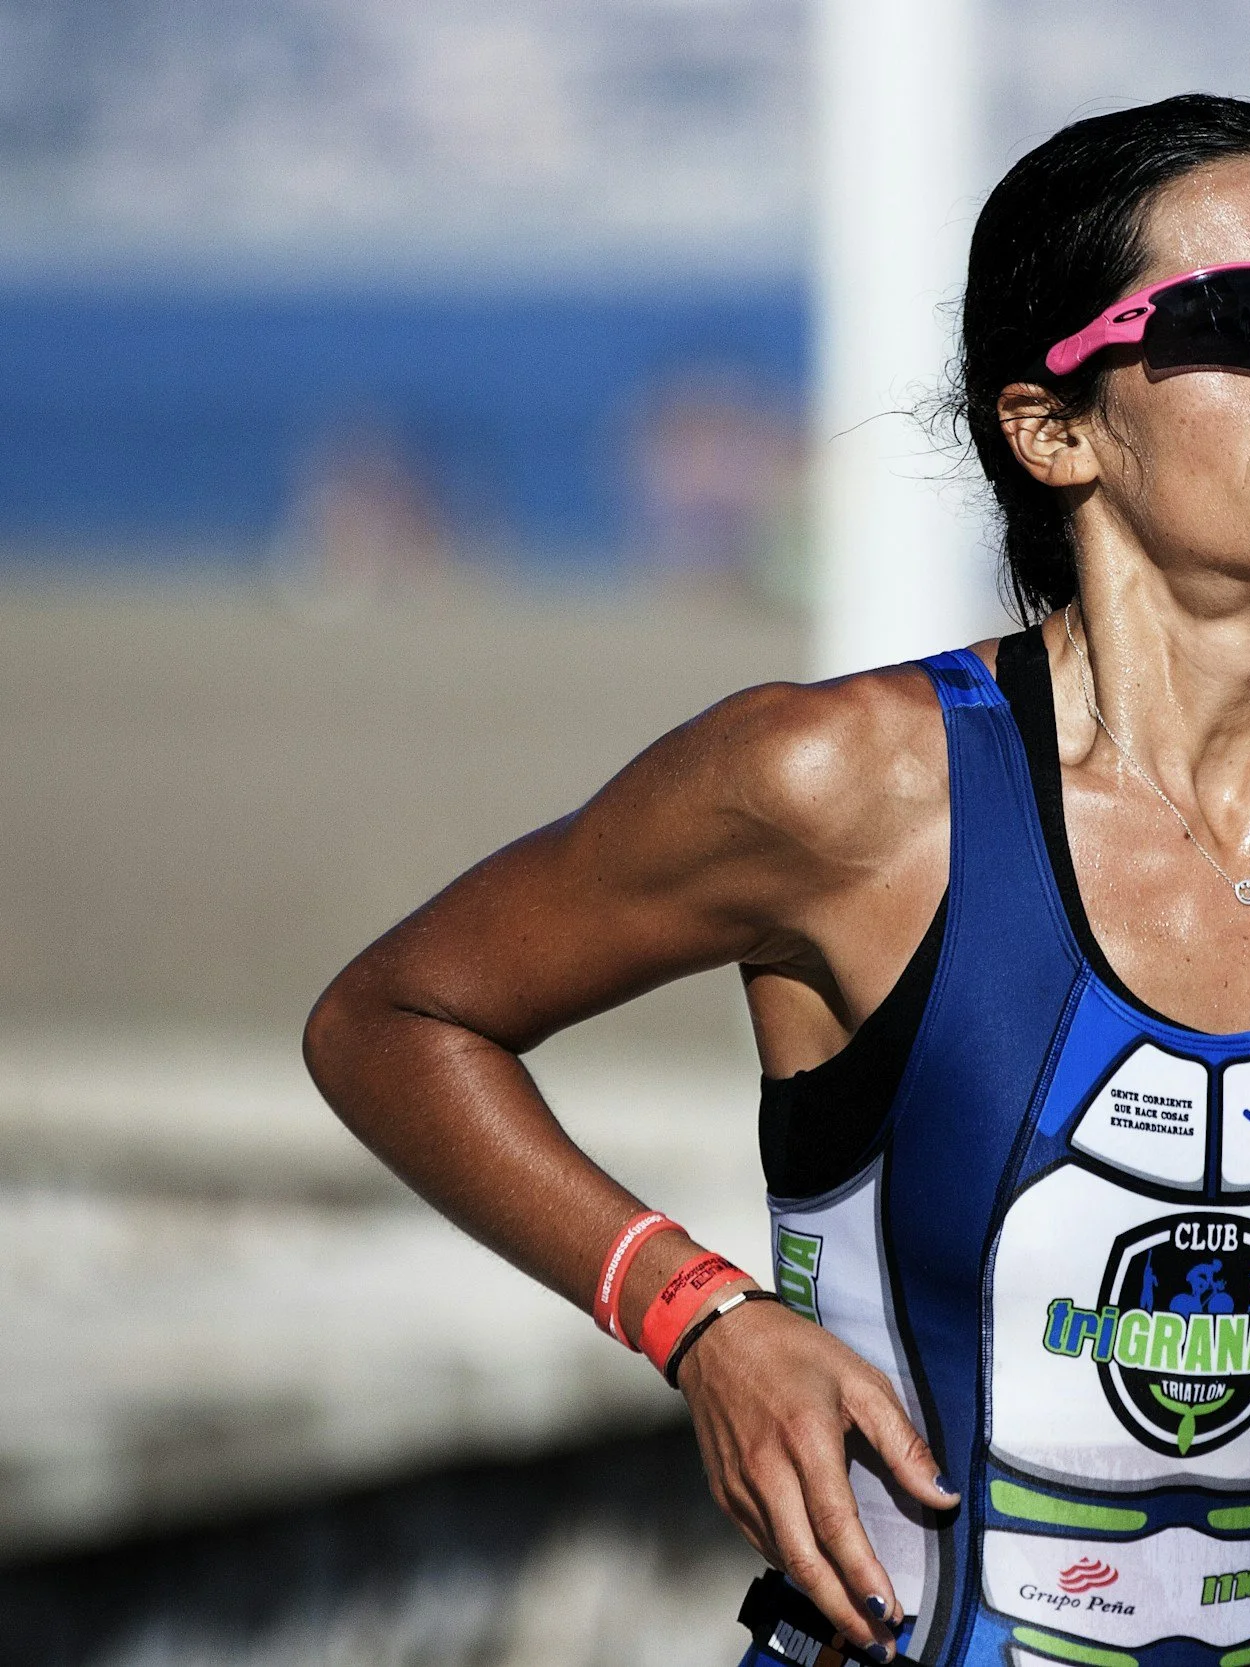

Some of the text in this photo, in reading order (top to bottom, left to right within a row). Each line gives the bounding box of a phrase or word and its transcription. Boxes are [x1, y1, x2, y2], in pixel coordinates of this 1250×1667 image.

[1110, 1089, 1192, 1108] GENTE CORRIENTE
[1114, 1103, 1189, 1122] QUE HACE COSAS
[1110, 1117, 1194, 1136] EXTRAORDINARIAS
[1174, 1222, 1239, 1251] CLUB
[1019, 1584, 1136, 1616] Grupo Peña
